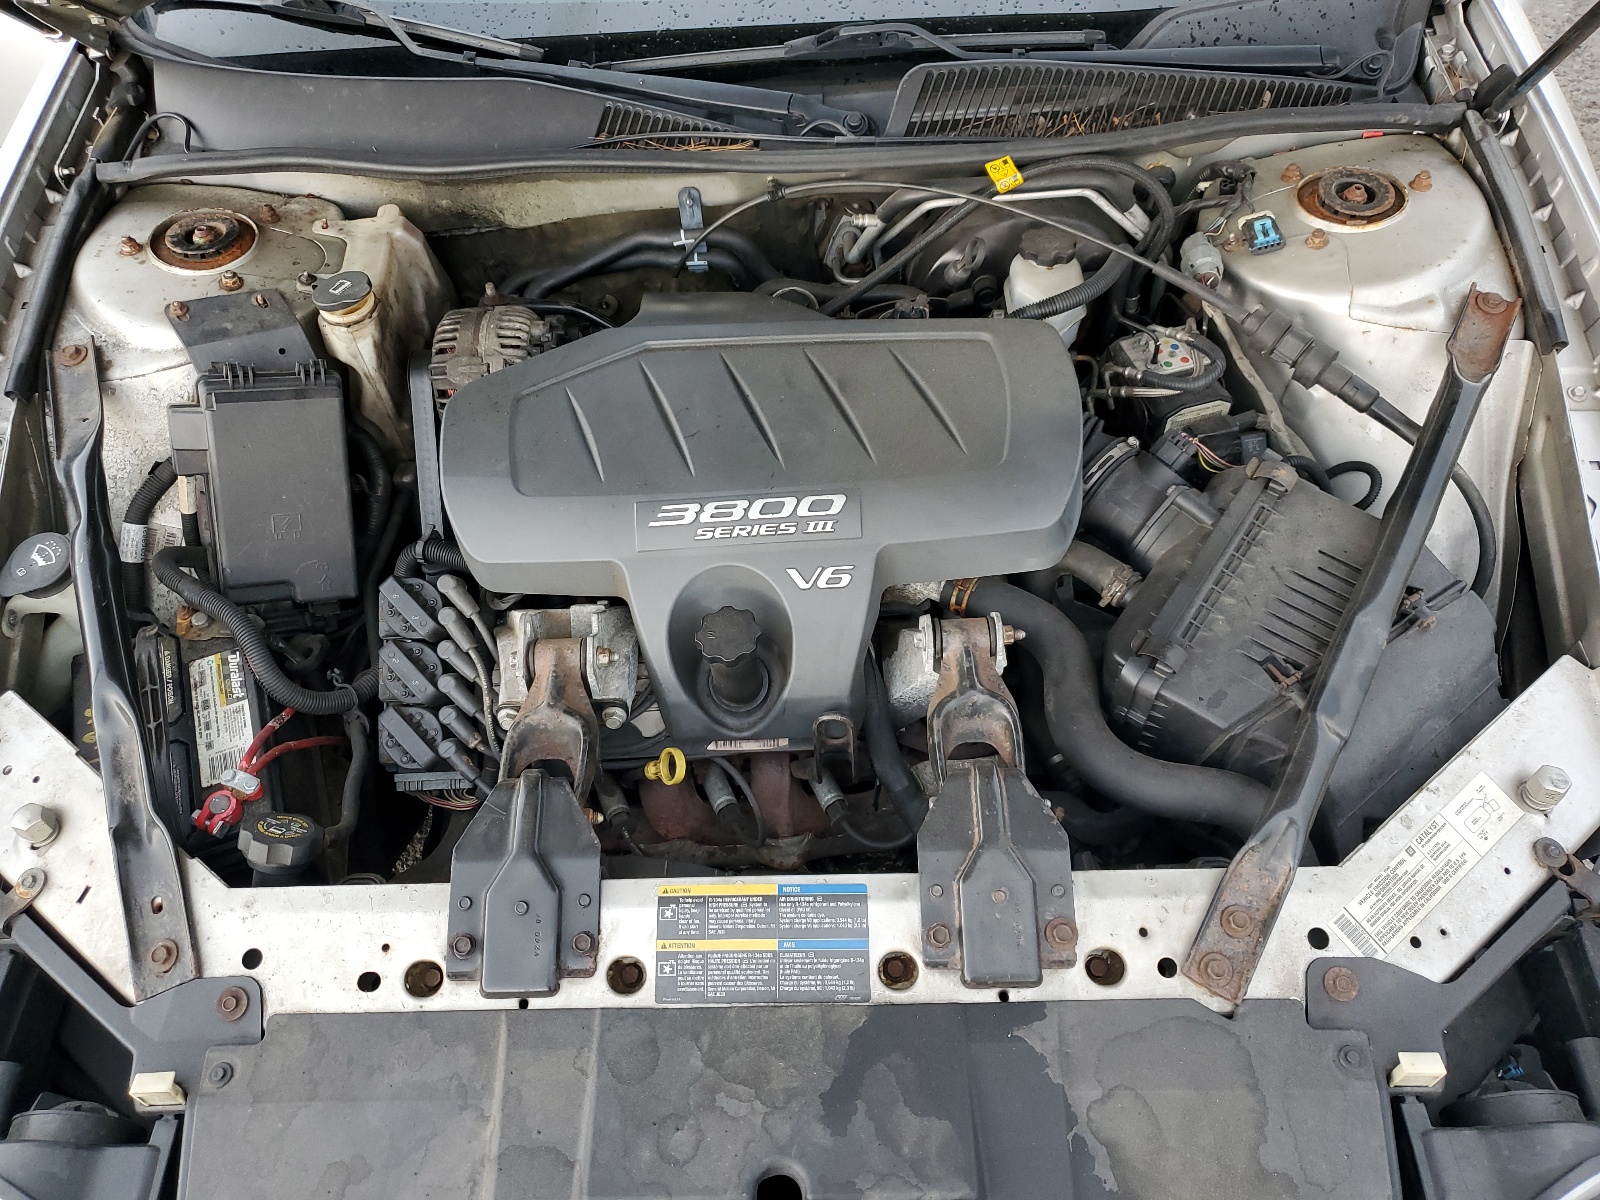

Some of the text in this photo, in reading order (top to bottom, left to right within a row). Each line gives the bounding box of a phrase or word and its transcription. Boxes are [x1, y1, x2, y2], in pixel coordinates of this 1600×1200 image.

[648, 493, 847, 528] 3800
[694, 520, 839, 540] SERIES III
[785, 565, 855, 591] V6
[227, 651, 244, 699] Duralast
[1414, 820, 1439, 845] CATALYST
